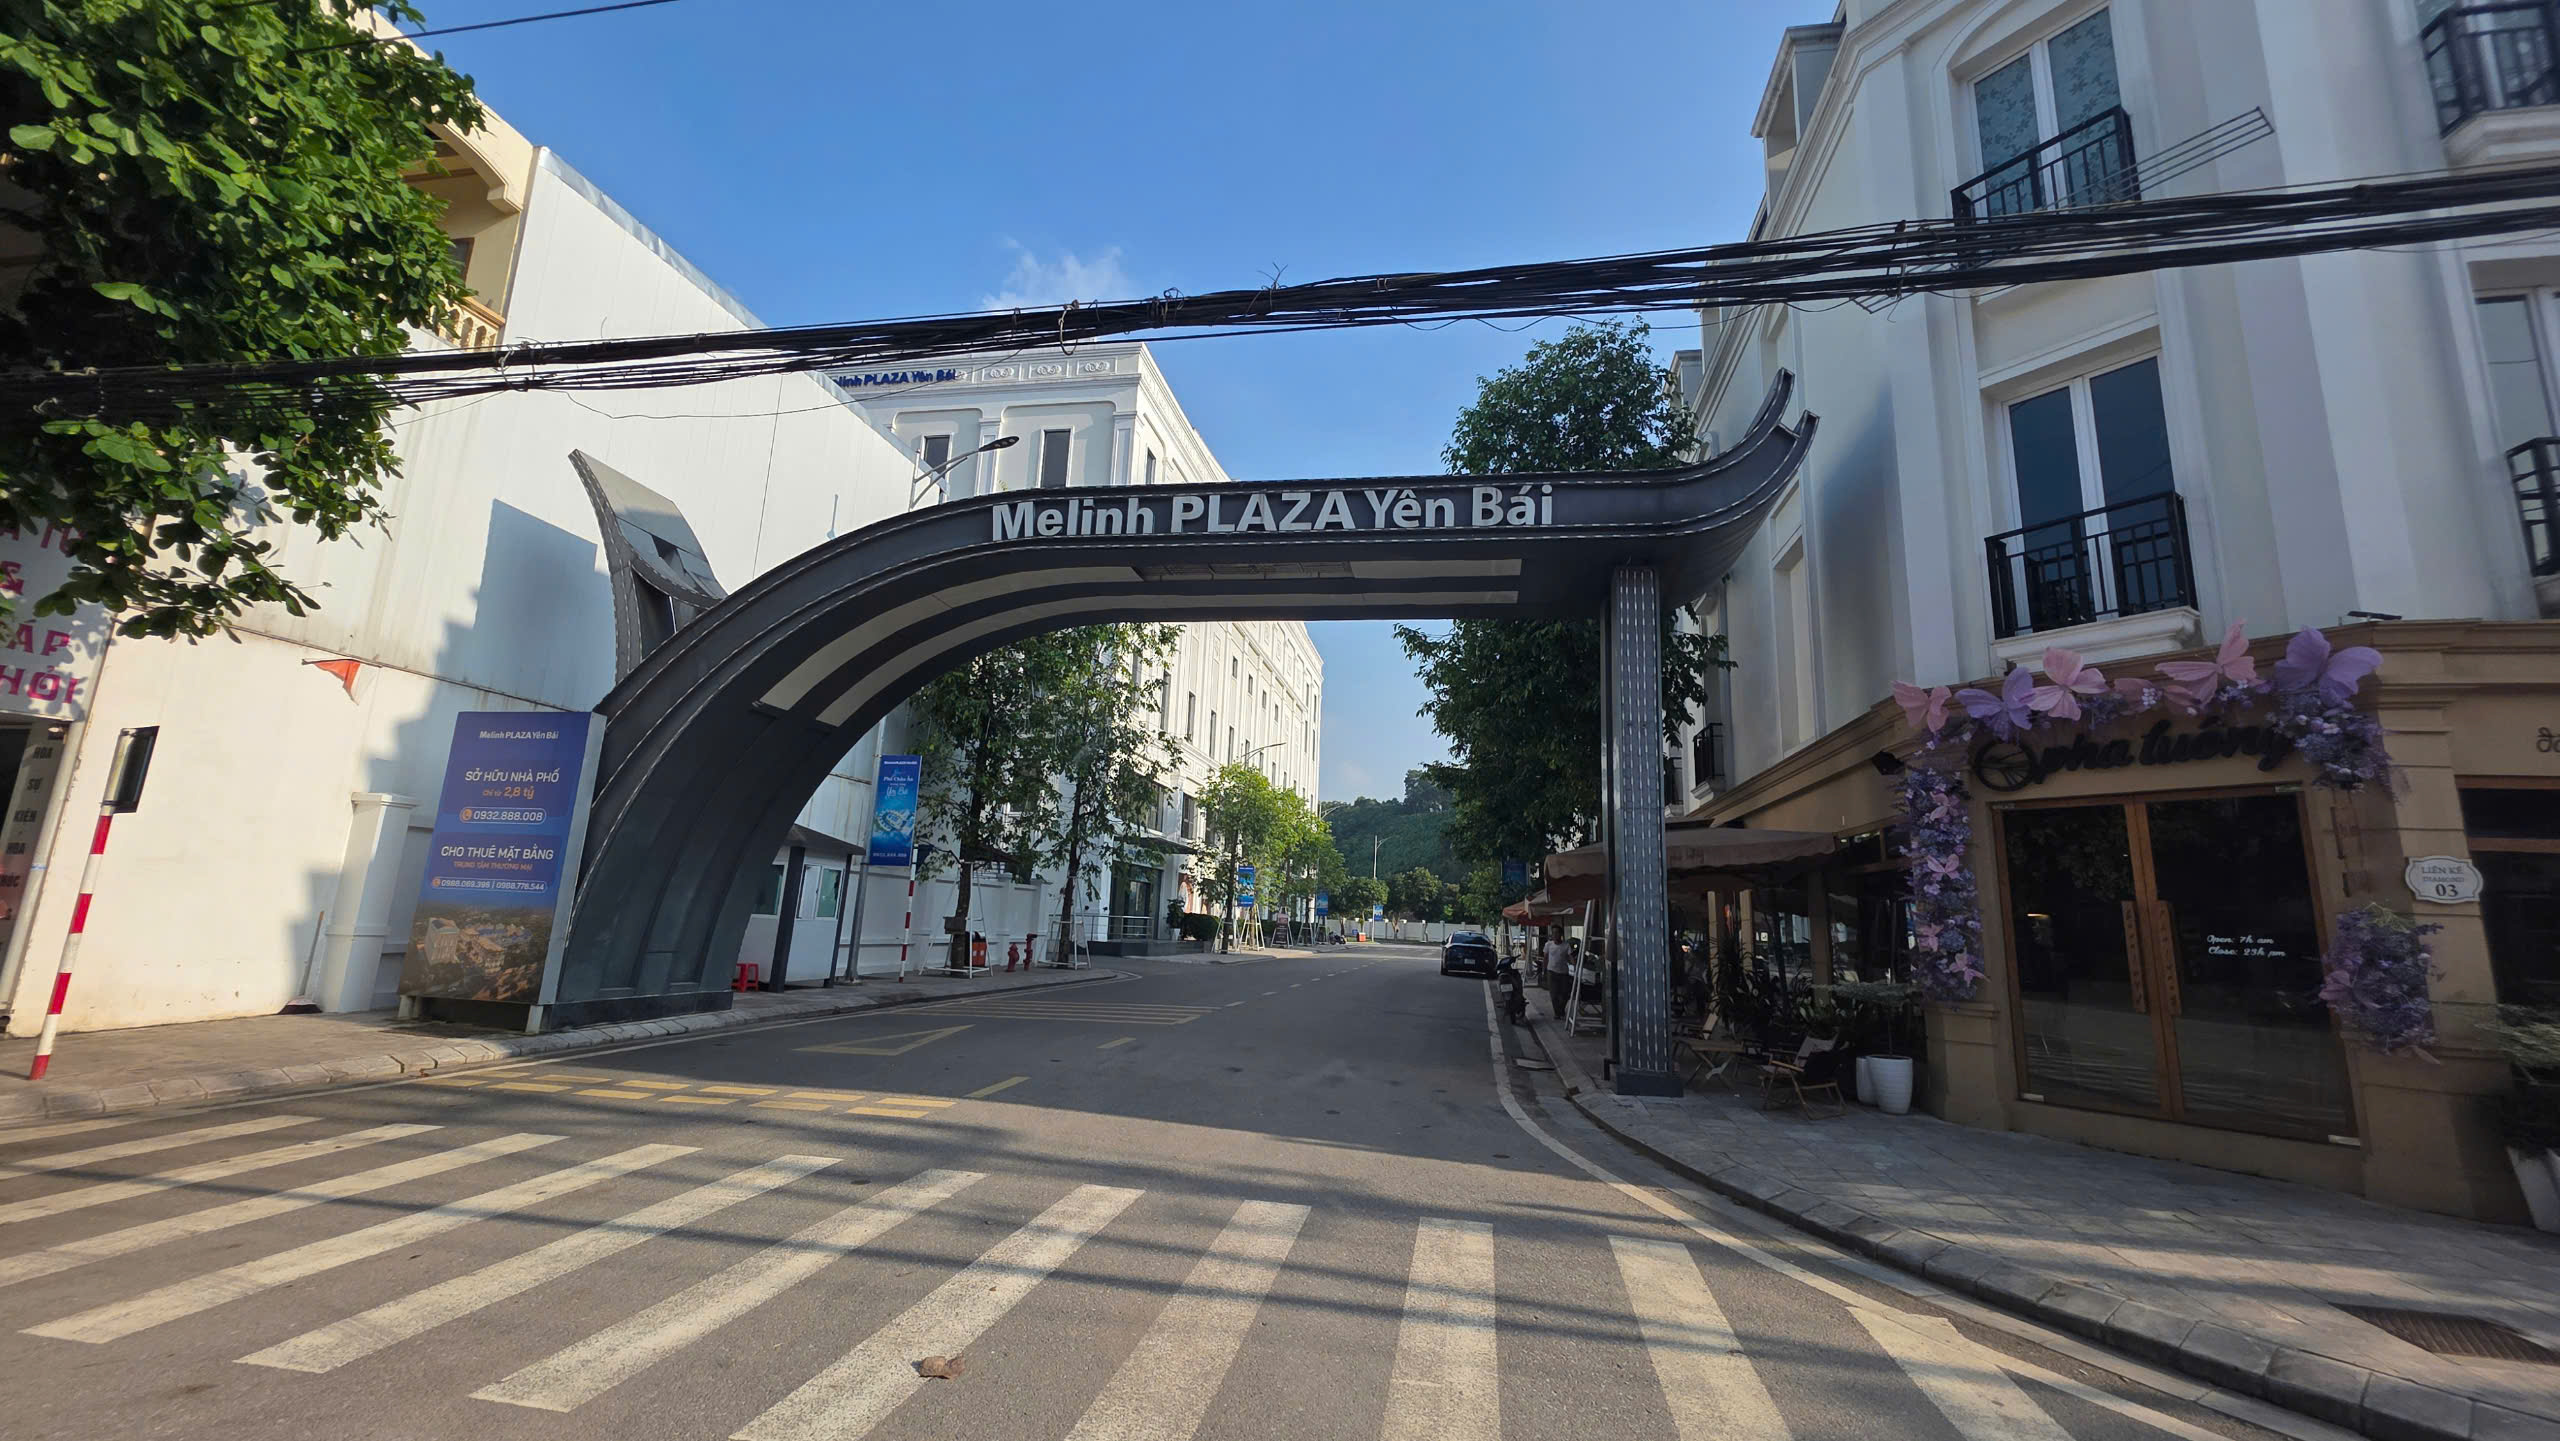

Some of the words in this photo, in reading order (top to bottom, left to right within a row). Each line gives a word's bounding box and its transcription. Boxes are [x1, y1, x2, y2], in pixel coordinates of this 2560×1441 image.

[864, 372, 909, 385] PLAZA
[992, 496, 1154, 541] Melinh
[1170, 490, 1355, 534] PLAZA
[1362, 489, 1454, 529] Yên
[1471, 483, 1554, 527] Bái
[2, 619, 71, 656] ÁP
[479, 730, 504, 740] Melinh
[505, 731, 532, 740] PLAZA
[532, 731, 546, 740] Yên
[546, 731, 559, 740] Bái
[465, 768, 483, 781] SỞ
[483, 769, 508, 782] HỮU
[510, 768, 533, 782] NHÀ
[535, 767, 560, 783] PHỐ
[504, 786, 520, 799] 2,8
[473, 810, 543, 821] 0932.888.008
[441, 846, 465, 857] CHO
[467, 845, 496, 858] THUÊ
[497, 845, 521, 861] MẶT
[522, 844, 554, 860] BẰNG
[2435, 883, 2459, 897] 03
[2267, 950, 2287, 958] pm
